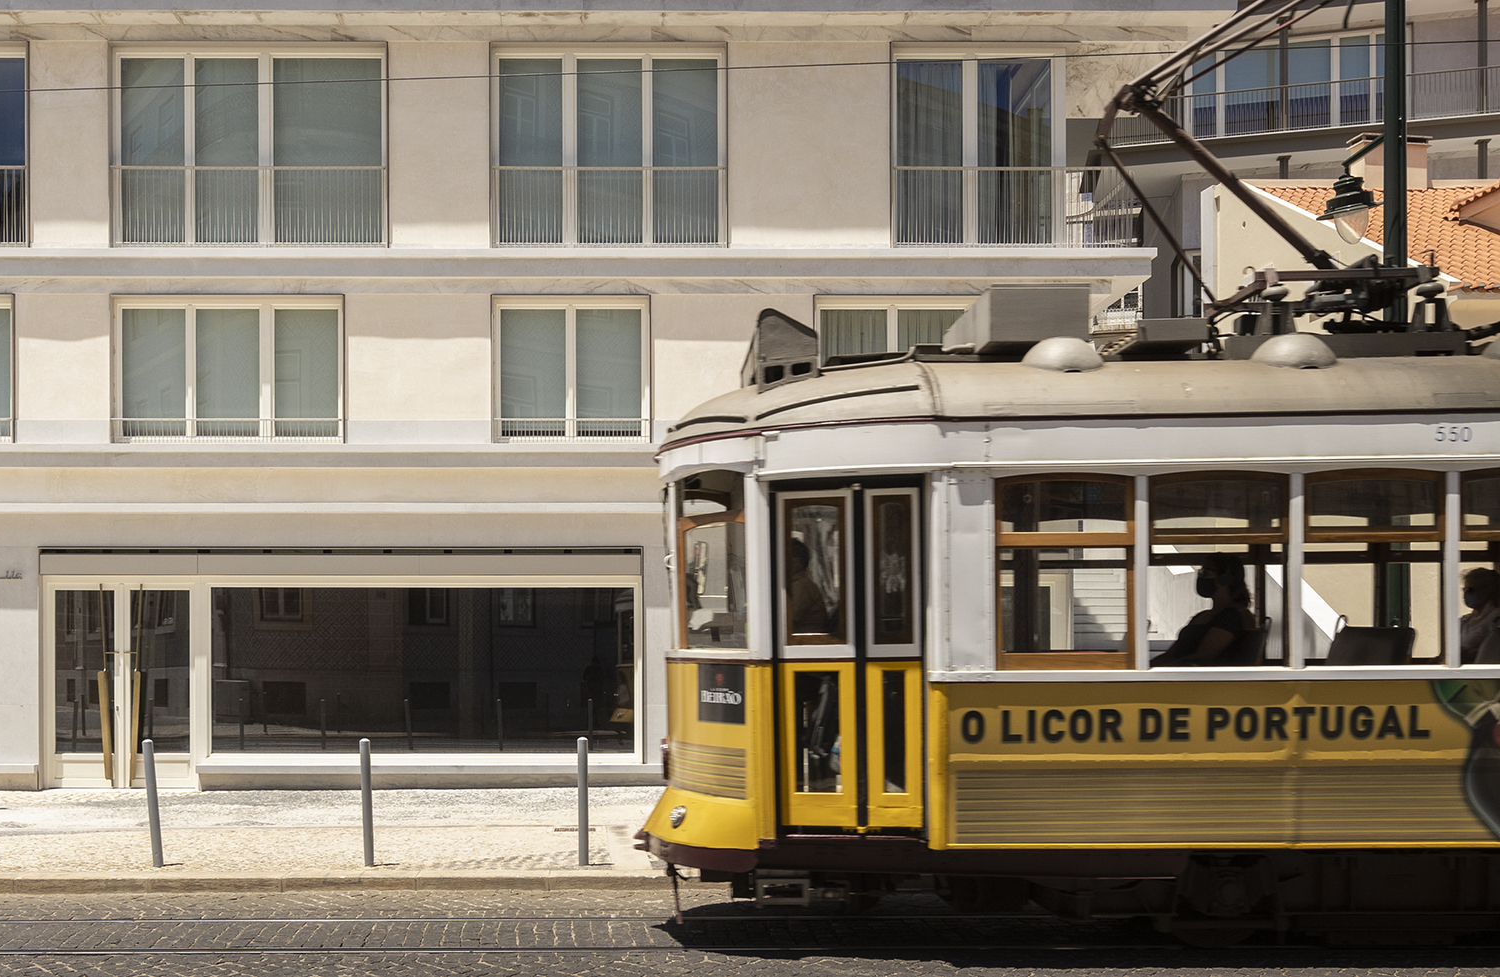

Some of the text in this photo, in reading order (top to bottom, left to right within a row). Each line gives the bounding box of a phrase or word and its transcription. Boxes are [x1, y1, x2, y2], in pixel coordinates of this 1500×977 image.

[1434, 426, 1473, 443] 550
[961, 705, 1431, 745] O LICOR DE PORTUGAL
